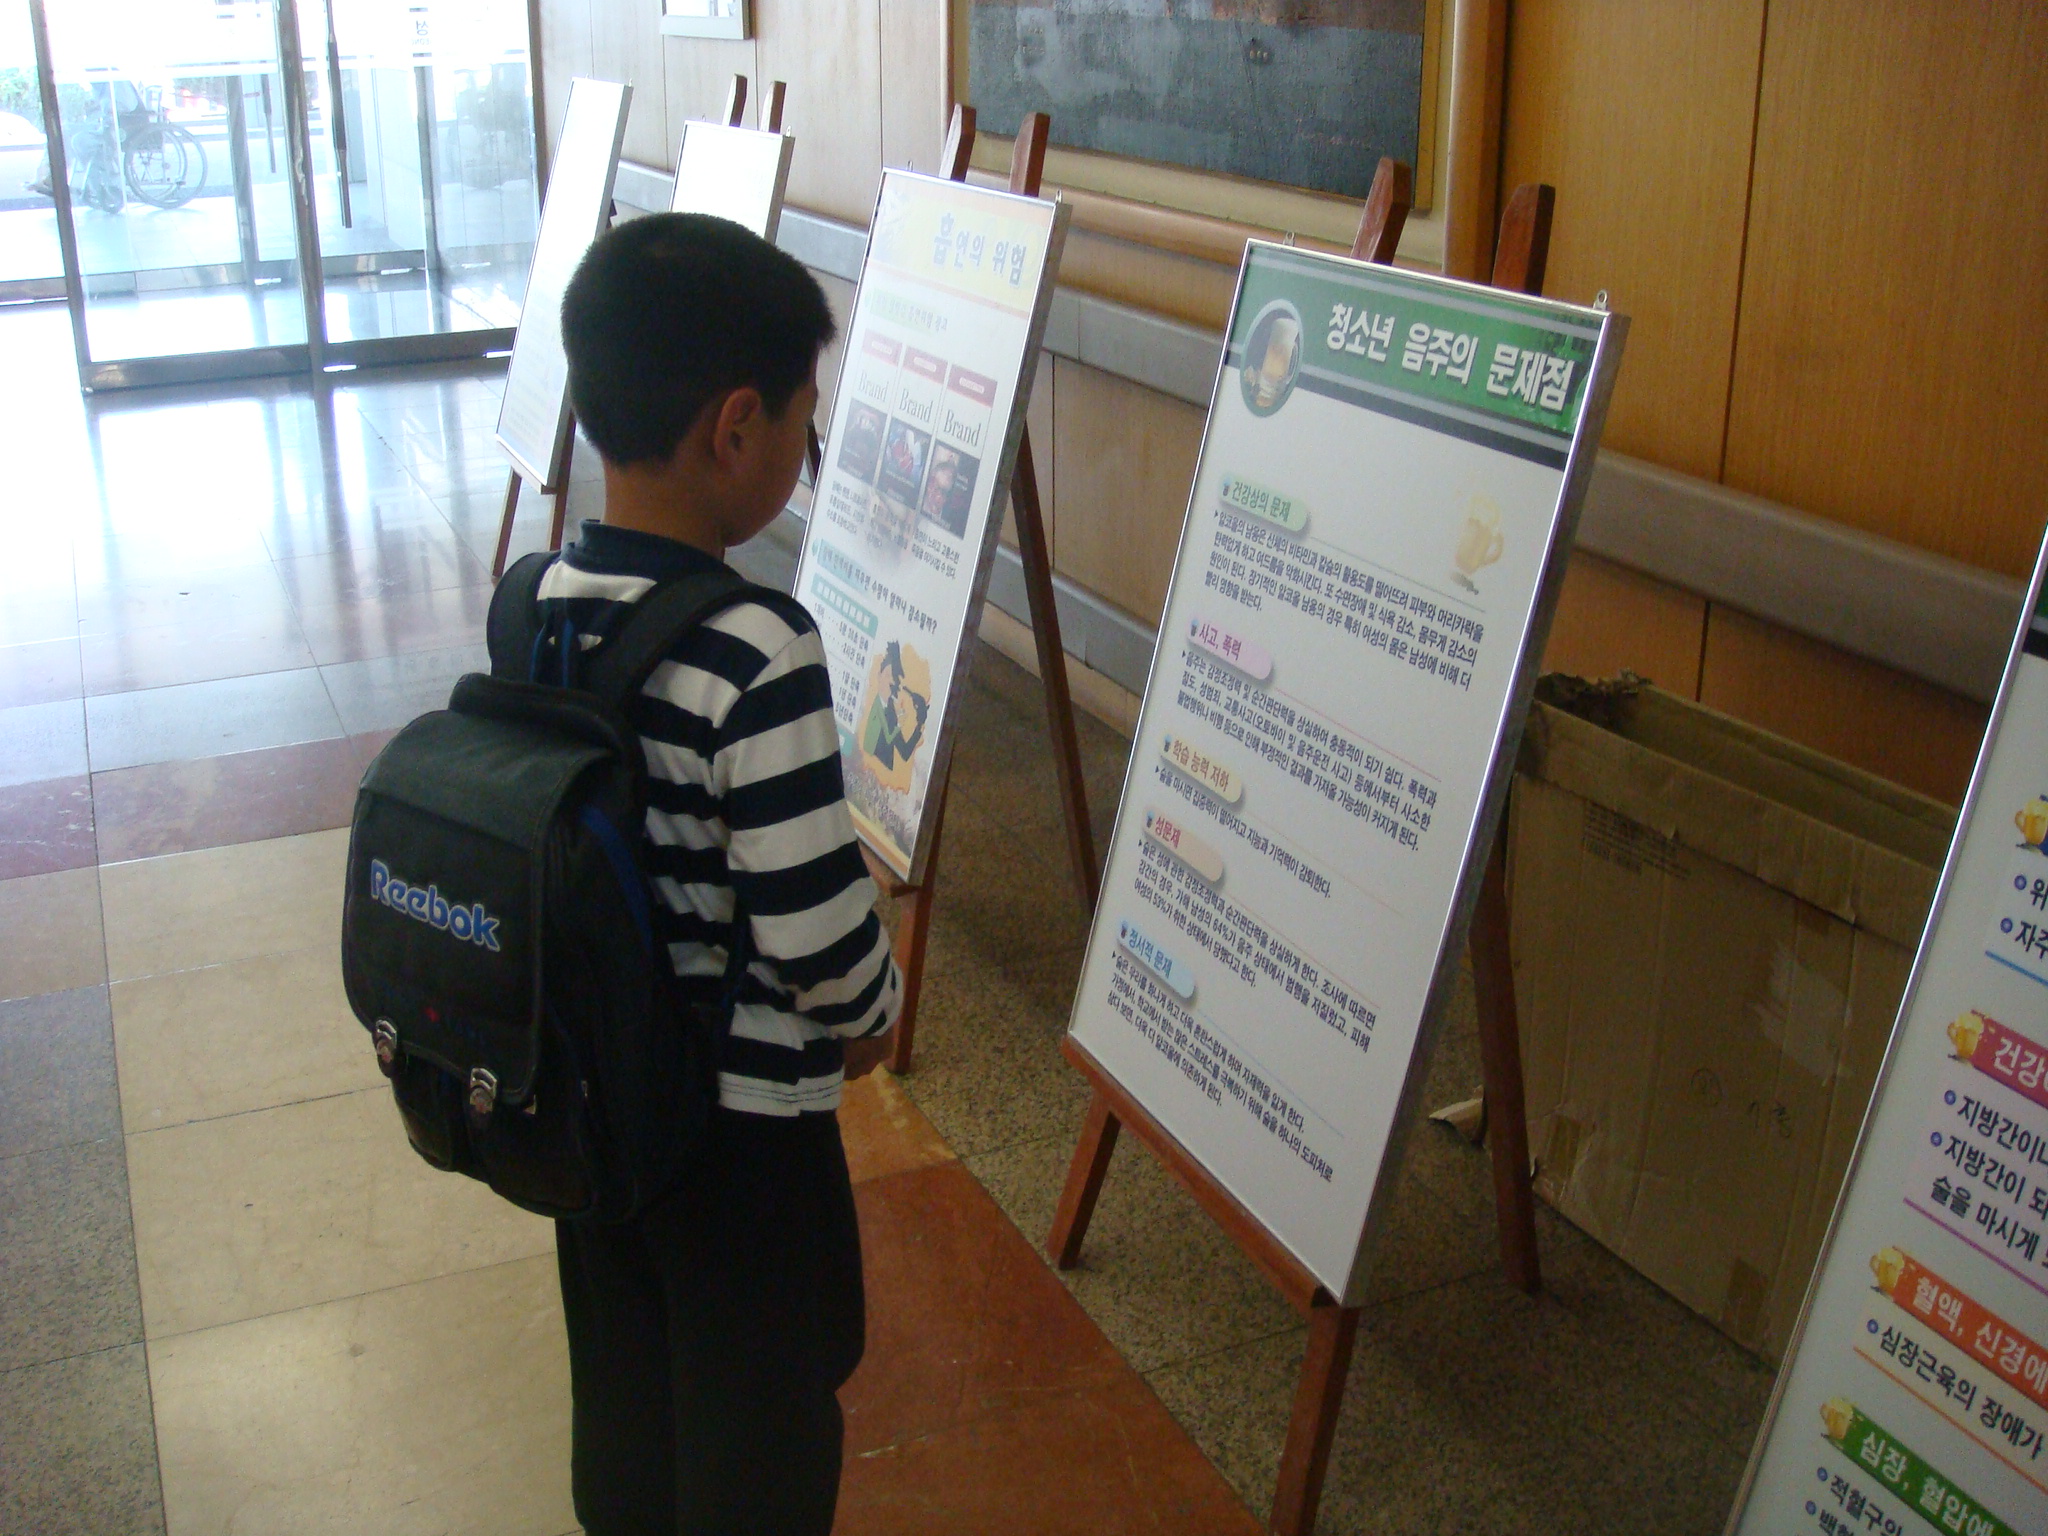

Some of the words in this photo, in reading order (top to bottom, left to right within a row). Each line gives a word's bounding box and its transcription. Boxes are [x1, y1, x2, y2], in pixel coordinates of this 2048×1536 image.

[933, 212, 985, 271] 흡연의
[992, 241, 1026, 286] 위험
[1326, 303, 1394, 361] 청소년
[1401, 322, 1478, 383] 음주의
[1486, 343, 1573, 409] 문제점
[899, 388, 933, 423] Brand
[944, 411, 982, 447] Brand
[1231, 480, 1270, 513] 건강상의
[1268, 495, 1292, 523] 문제
[1197, 622, 1219, 650] 사고,
[1221, 633, 1242, 661] 폭력
[1171, 738, 1190, 766] 학습
[1189, 750, 1210, 779] 능력
[1209, 764, 1230, 792] 저하
[1154, 815, 1181, 849] 성문제
[370, 859, 501, 952] Reebok
[1127, 927, 1154, 963] 정서적
[1152, 949, 1173, 979] 문제
[1994, 1037, 2048, 1091] 건강
[1944, 1135, 2026, 1204] 지방간이
[1931, 1175, 1972, 1219] 술을
[1976, 1202, 2040, 1262] 마시게
[1912, 1276, 1963, 1337] 혈액,
[1880, 1326, 1977, 1411] 심장근육의
[1980, 1395, 2044, 1460] 장애가
[1860, 1432, 1909, 1491] 심장,
[1919, 1474, 1994, 1536] 혈압에
